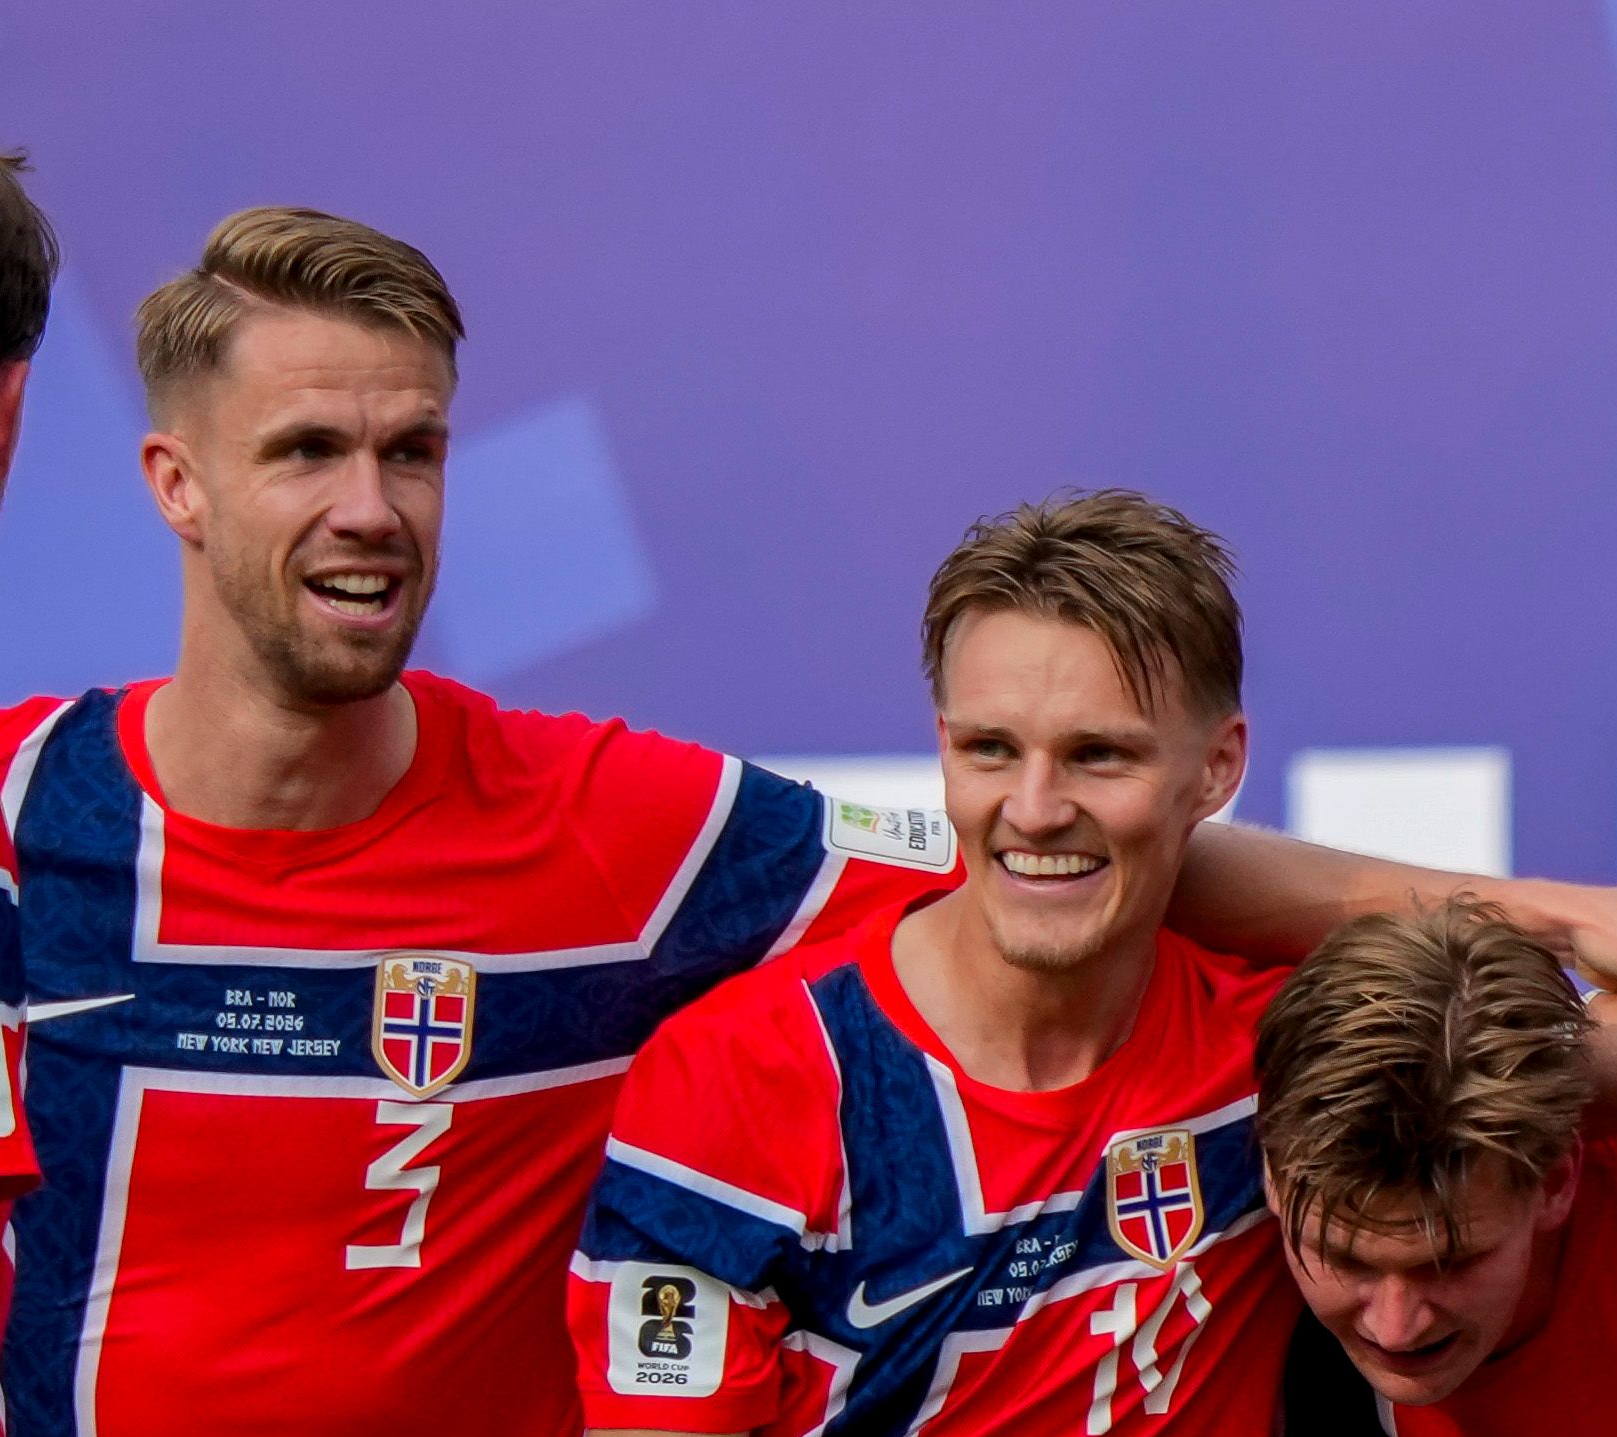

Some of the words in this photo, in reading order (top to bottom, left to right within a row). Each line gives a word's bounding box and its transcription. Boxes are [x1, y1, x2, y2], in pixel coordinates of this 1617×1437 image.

[225, 989, 252, 1007] BRA
[269, 991, 296, 1008] NOR
[215, 1012, 304, 1032] 05.07.2026
[176, 1032, 206, 1051] NEW
[211, 1035, 249, 1055] YORK
[252, 1039, 283, 1056] NEW
[287, 1039, 341, 1057] JERSEY
[346, 1100, 454, 1270] 3
[977, 1288, 1003, 1306] NEW
[651, 1341, 678, 1355] FIFA
[1086, 1261, 1213, 1436] 10
[637, 1362, 669, 1371] WORLD
[671, 1363, 690, 1371] CUP
[635, 1371, 688, 1385] 2026
